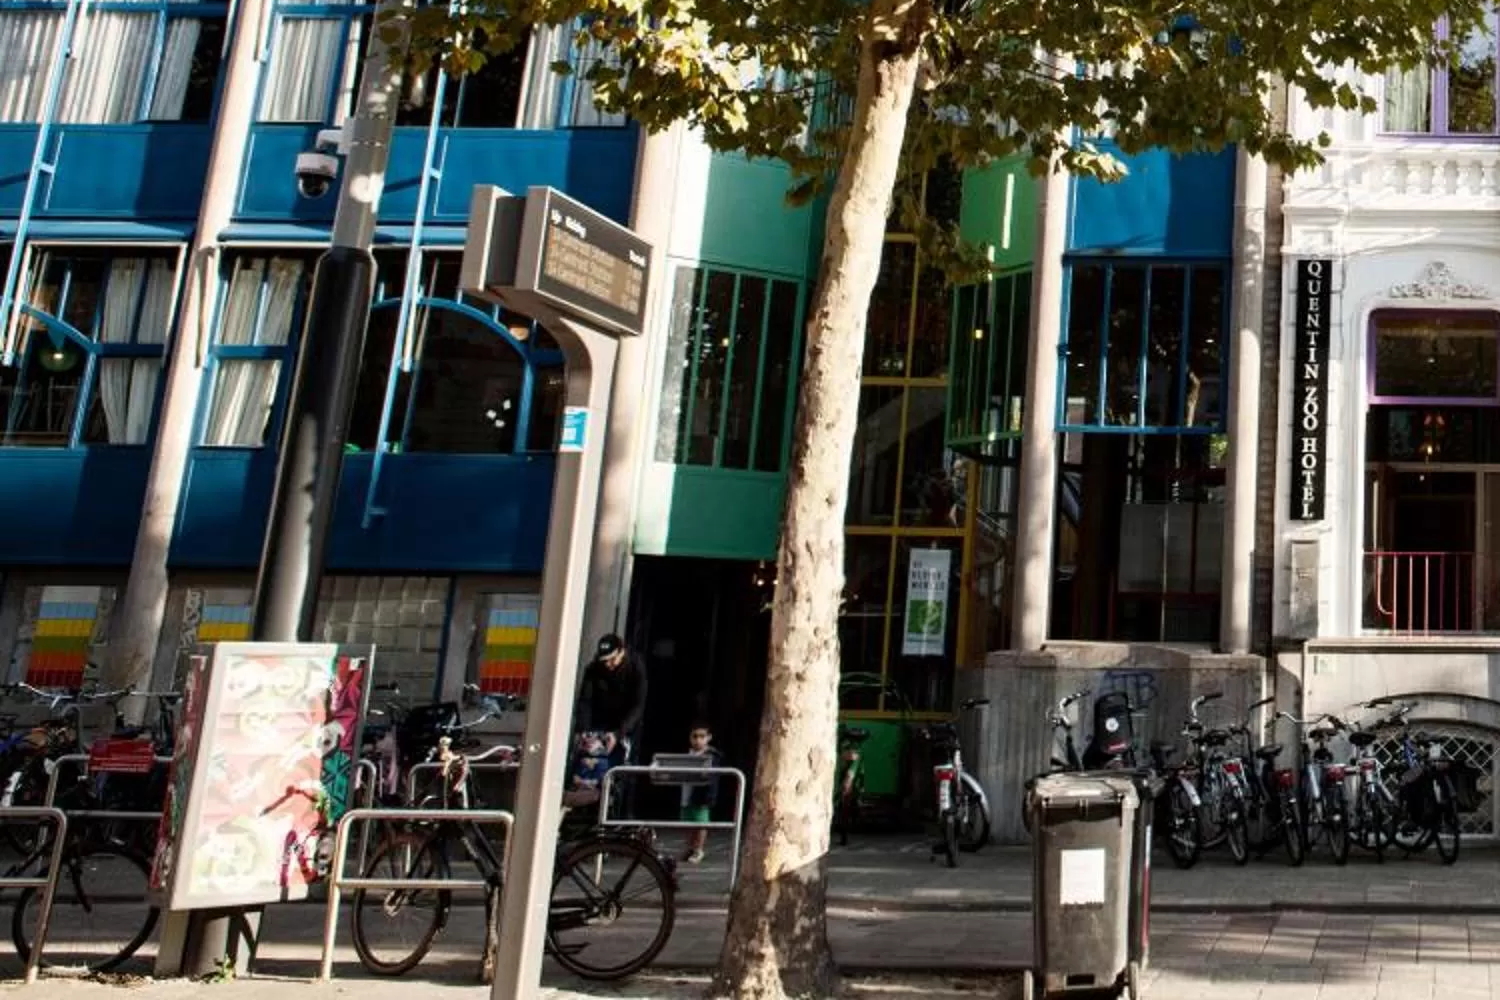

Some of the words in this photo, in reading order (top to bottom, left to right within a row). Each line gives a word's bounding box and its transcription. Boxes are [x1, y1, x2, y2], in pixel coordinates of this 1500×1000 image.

[1304, 261, 1322, 379] QUENTIN
[1303, 386, 1318, 430] ZOO
[1301, 437, 1318, 518] HOTEL
